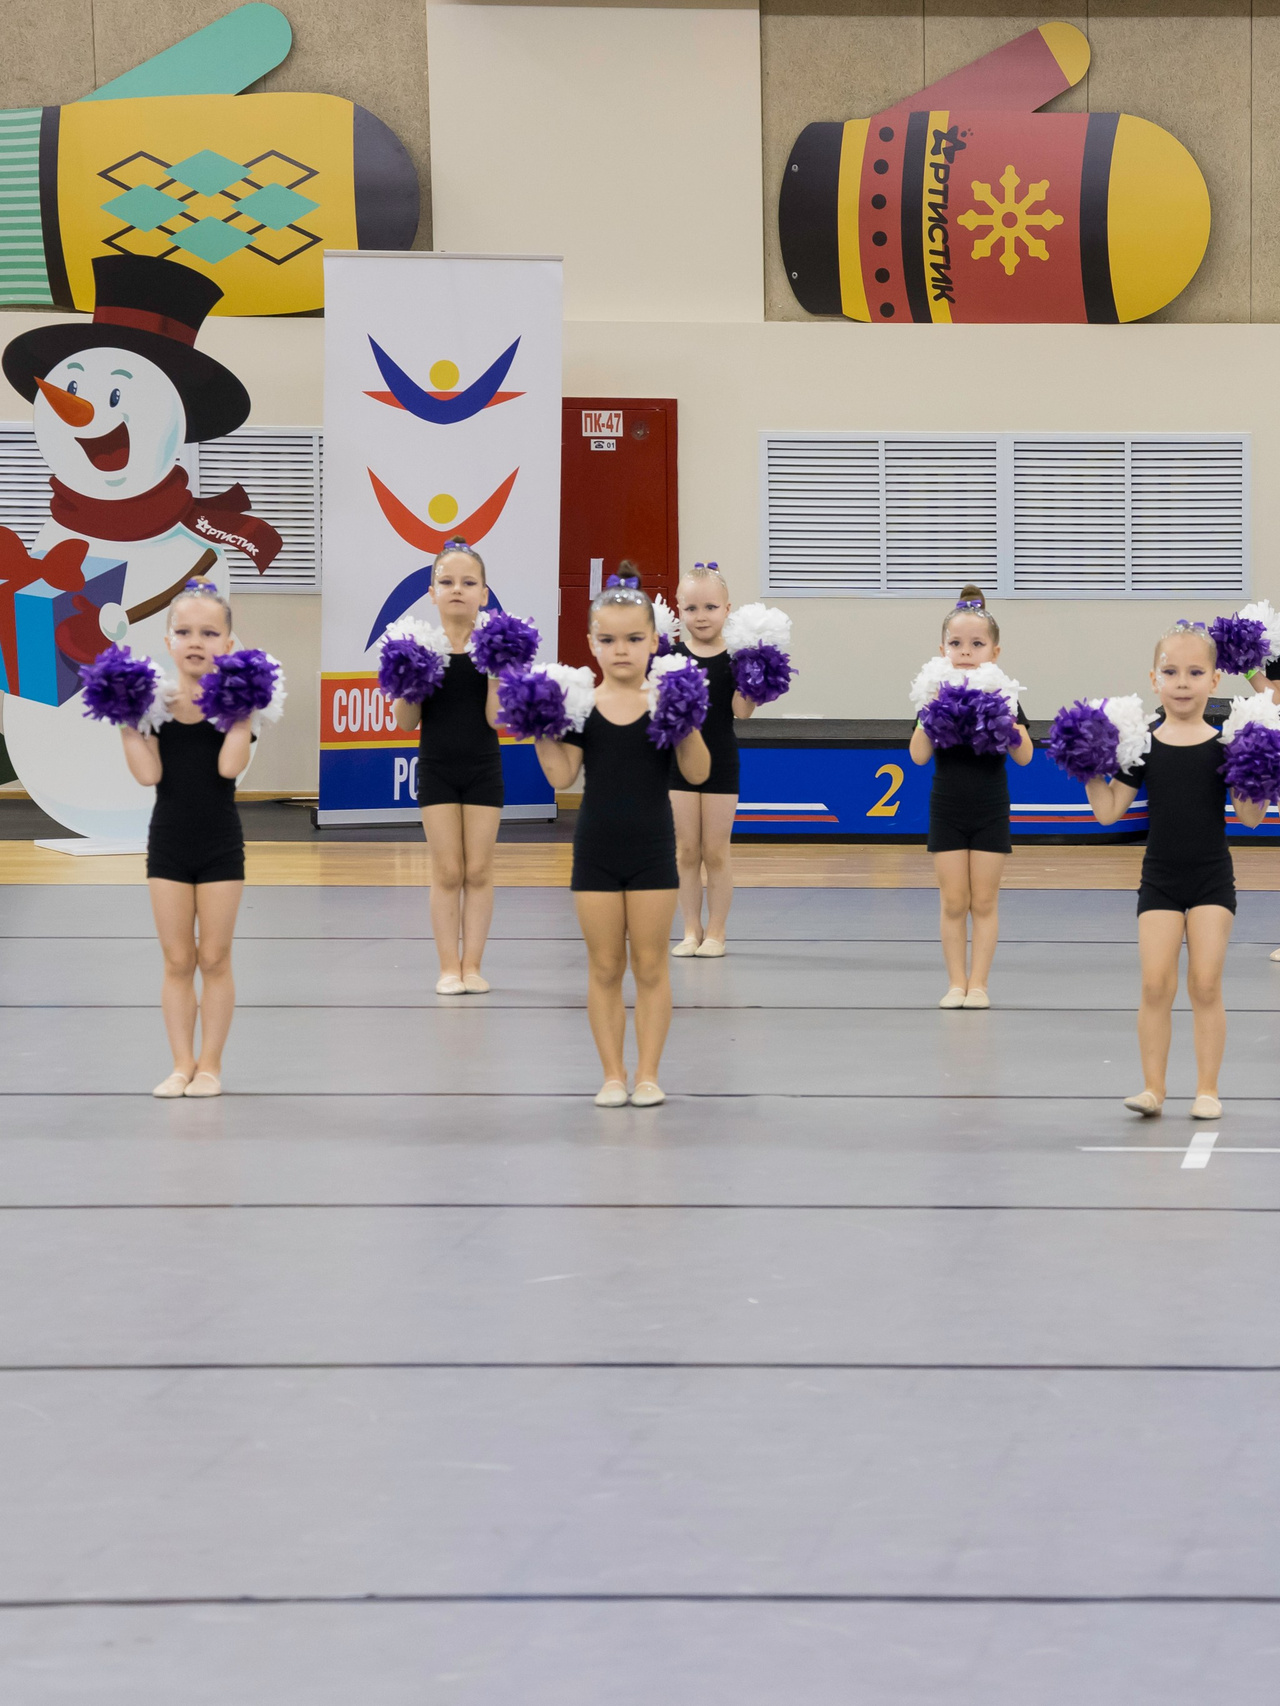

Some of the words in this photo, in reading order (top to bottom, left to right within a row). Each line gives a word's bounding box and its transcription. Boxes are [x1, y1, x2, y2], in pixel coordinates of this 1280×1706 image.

[584, 412, 621, 433] ПК-47
[333, 687, 398, 733] СОЮЗ
[866, 763, 904, 817] 2
